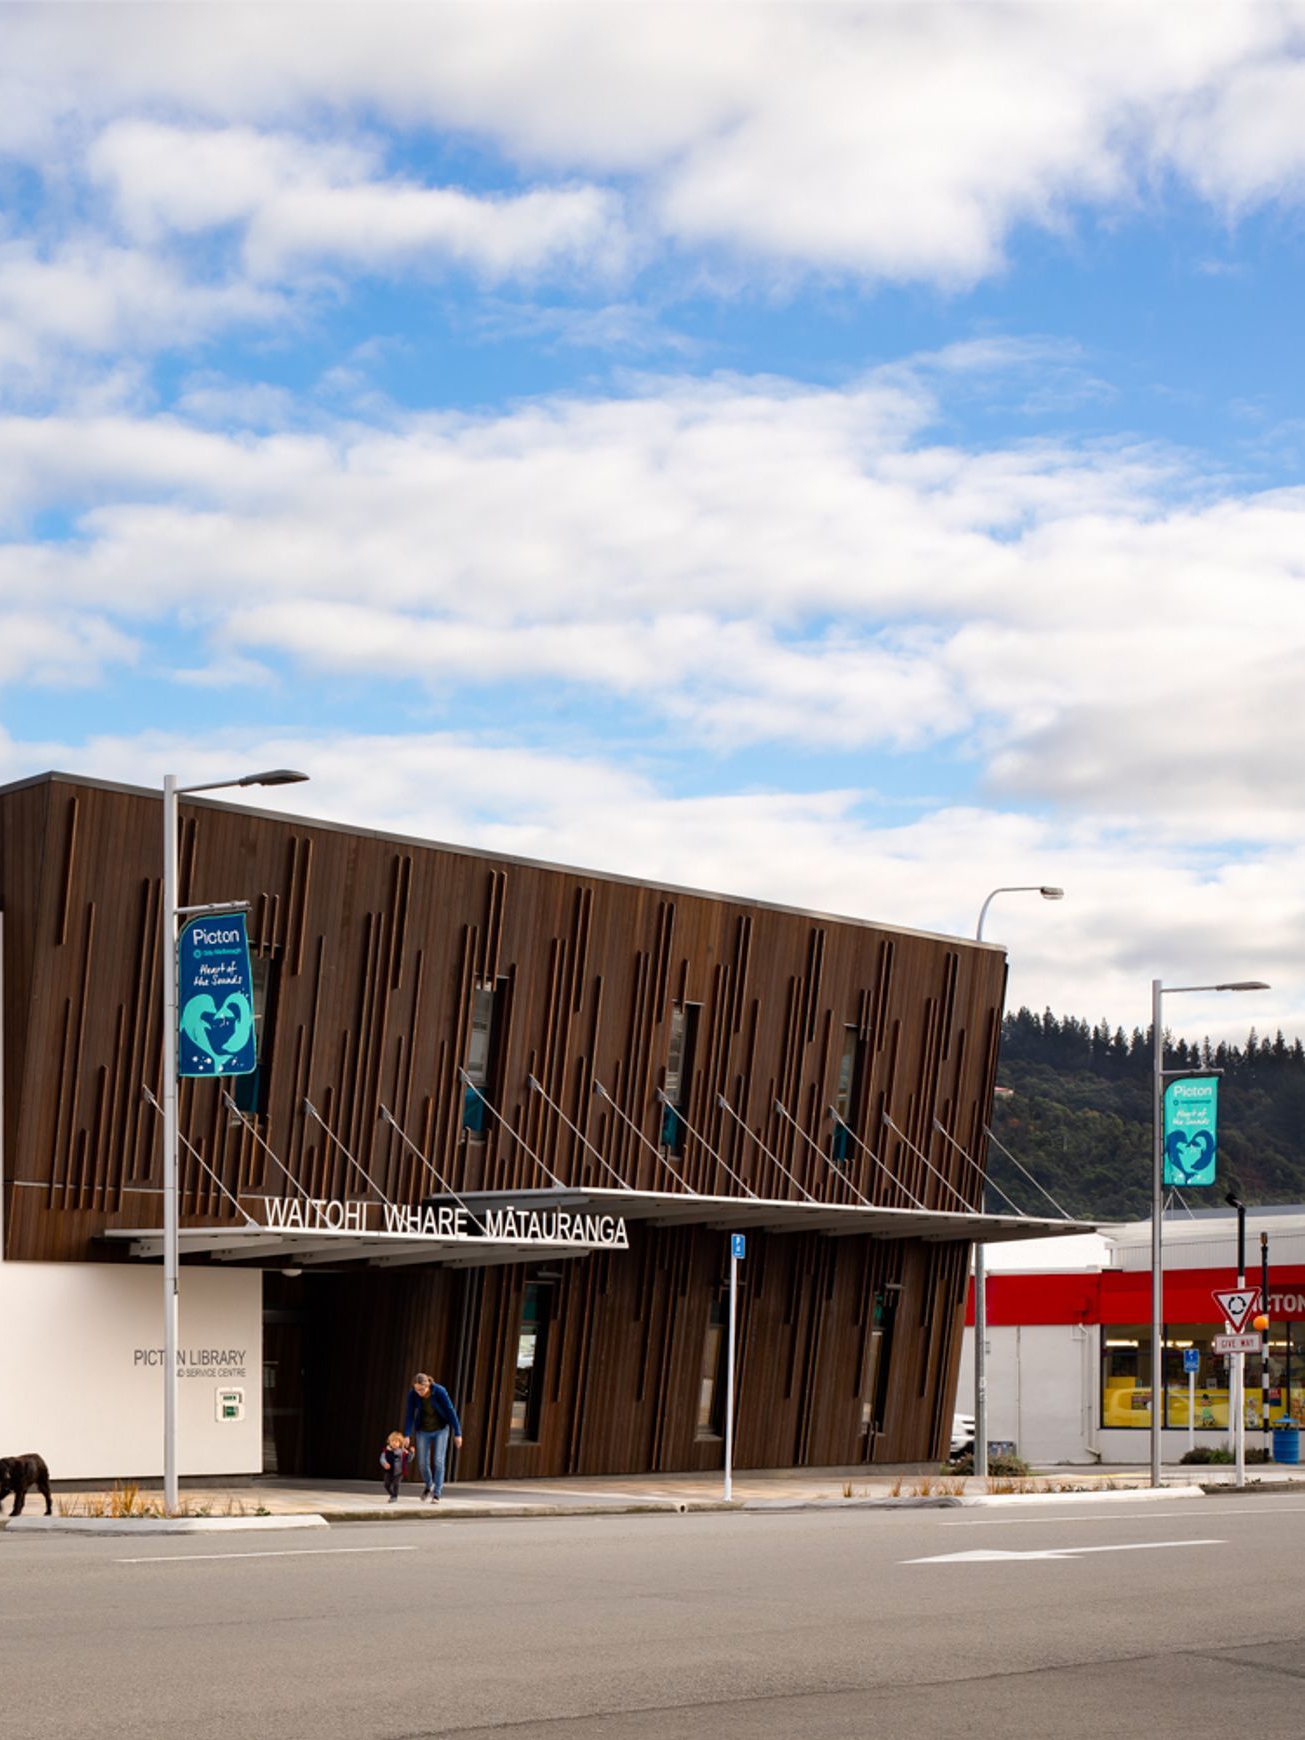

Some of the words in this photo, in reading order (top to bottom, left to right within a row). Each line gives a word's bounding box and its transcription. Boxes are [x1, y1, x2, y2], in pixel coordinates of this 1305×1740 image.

[193, 929, 240, 945] Picton
[1173, 1085, 1213, 1097] Picton
[264, 1196, 368, 1230] WAITOHI
[383, 1203, 469, 1237] WHARE
[485, 1206, 629, 1245] MĀTAURANGA
[133, 1349, 186, 1366] PICTN
[189, 1349, 247, 1366] LIBRARY
[186, 1367, 216, 1378] SERVICE
[217, 1367, 246, 1378] CENTRE
